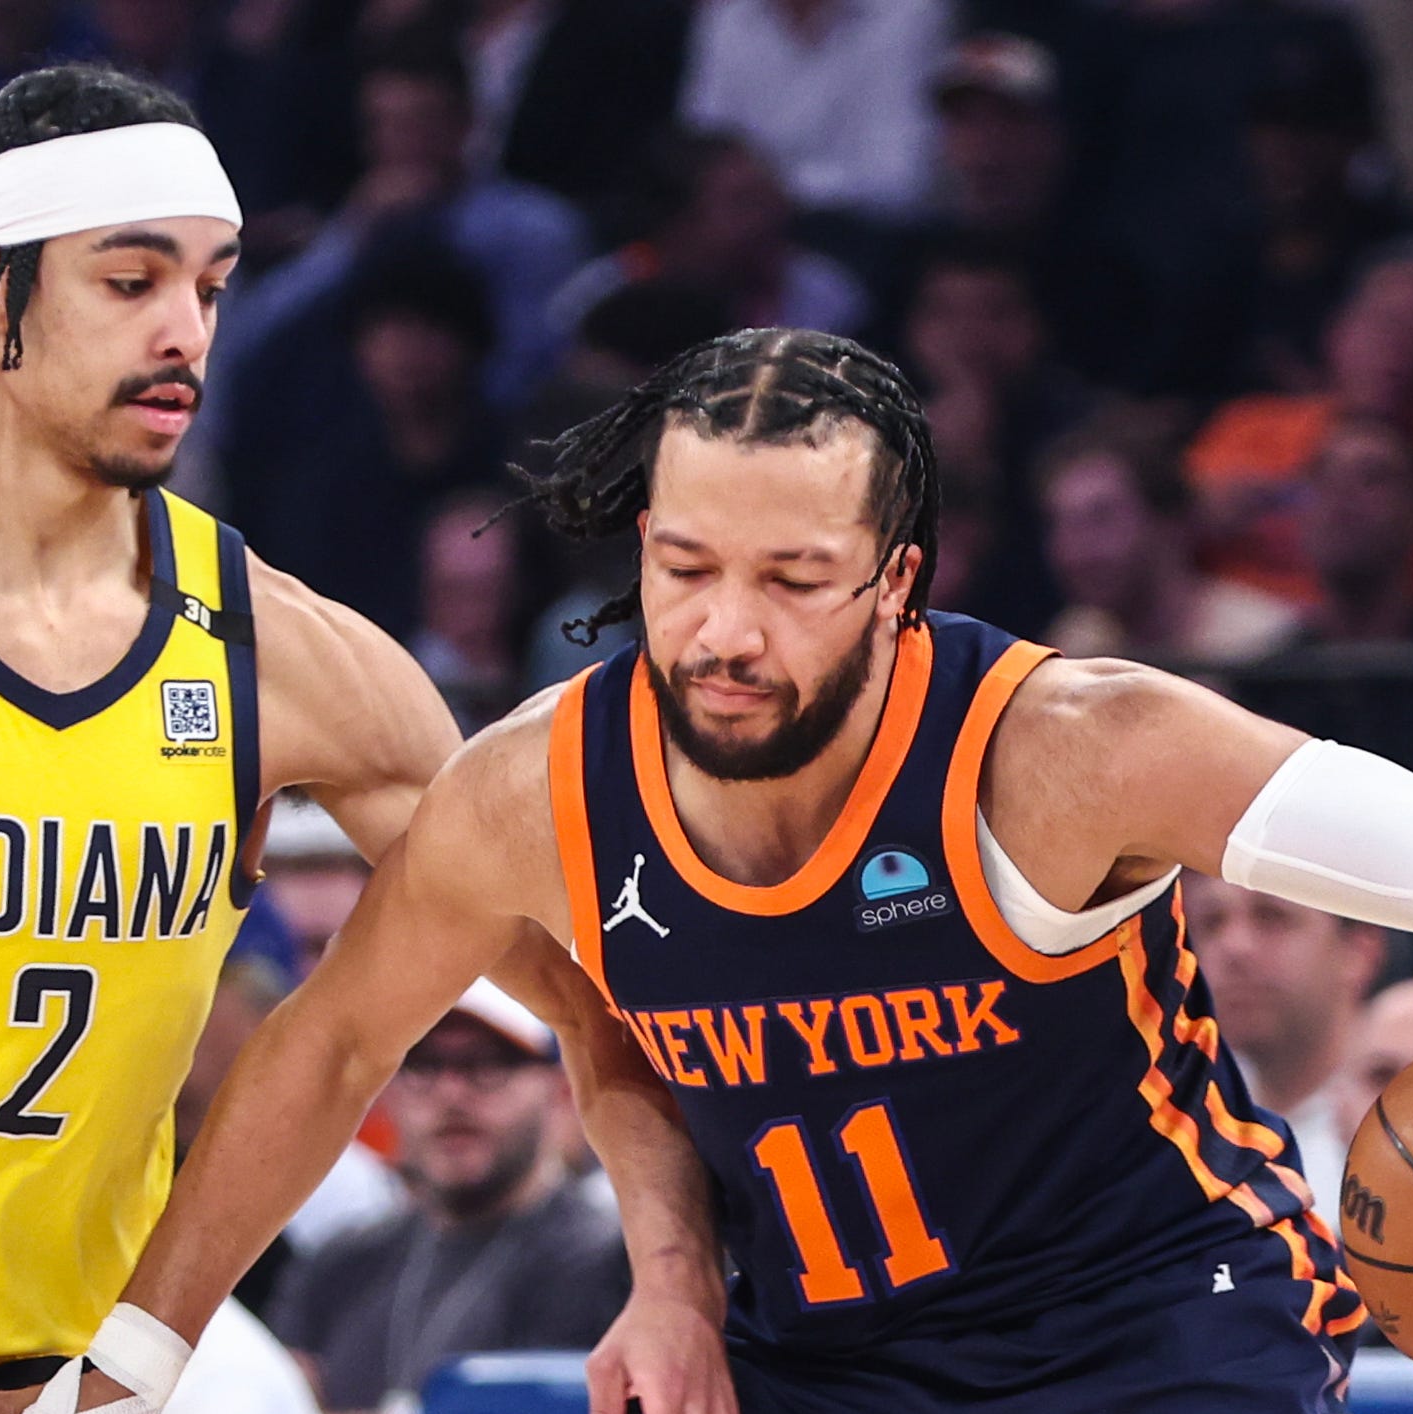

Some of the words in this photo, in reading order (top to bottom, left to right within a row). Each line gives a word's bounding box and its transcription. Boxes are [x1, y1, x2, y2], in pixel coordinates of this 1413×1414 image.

[184, 597, 212, 631] 30
[861, 893, 947, 927] sphere
[776, 980, 1020, 1076] YORK
[749, 1100, 956, 1308] 11
